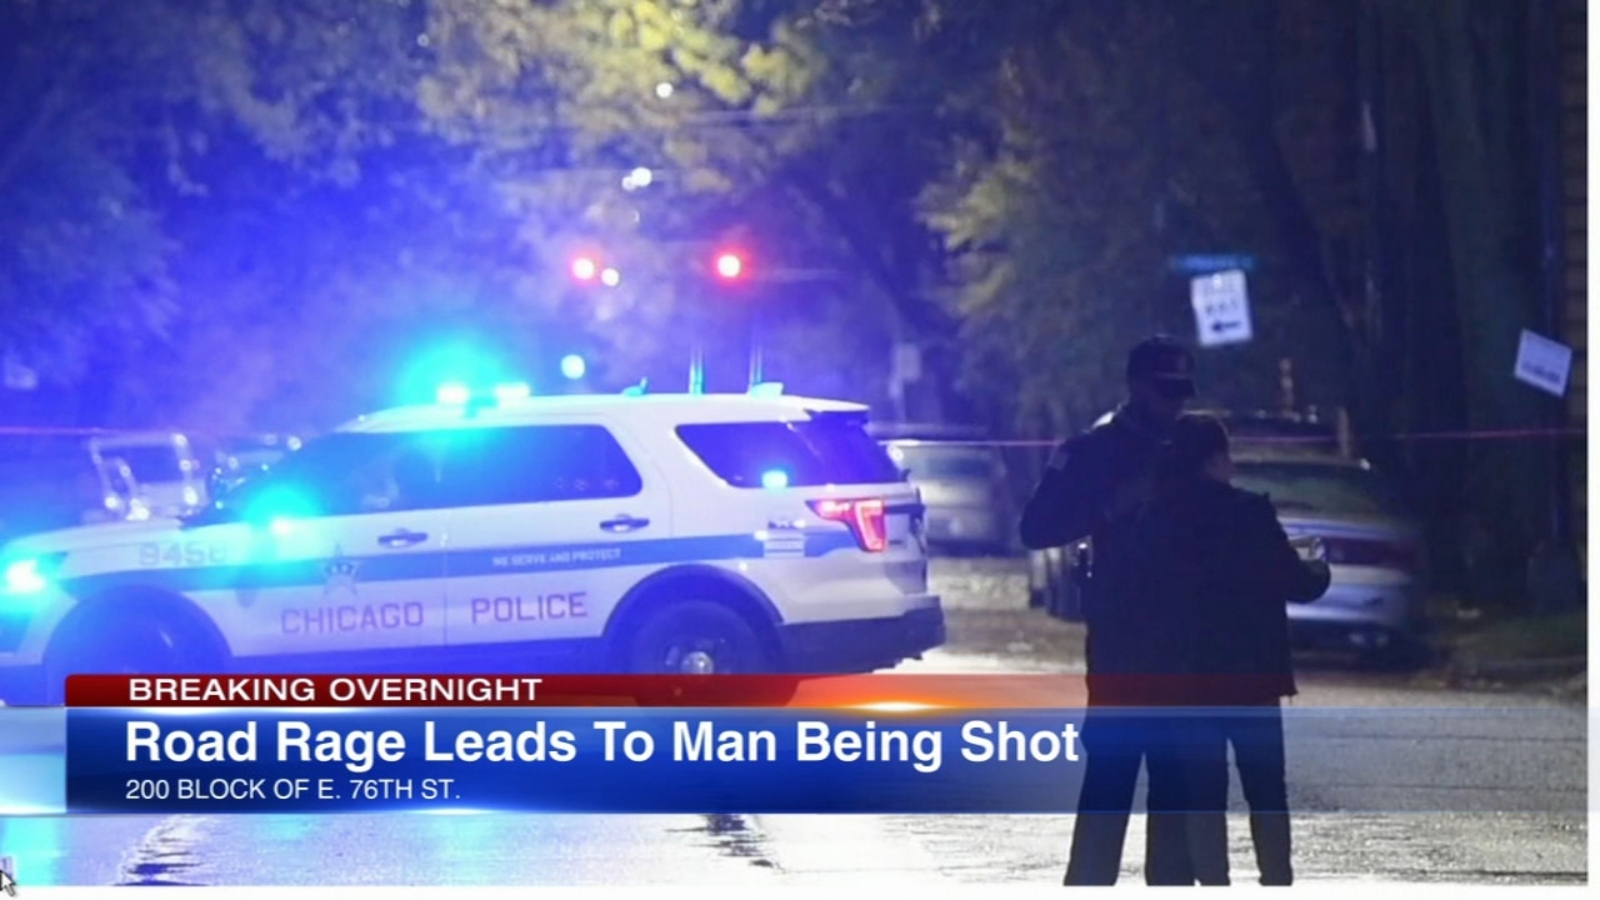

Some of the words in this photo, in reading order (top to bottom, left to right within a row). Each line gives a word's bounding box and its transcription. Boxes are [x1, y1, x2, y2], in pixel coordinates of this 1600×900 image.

[513, 554, 545, 566] SERVE
[549, 551, 571, 563] AND
[573, 547, 621, 562] PROTECT
[281, 601, 424, 634] CHICAGO
[471, 592, 588, 623] POLICE
